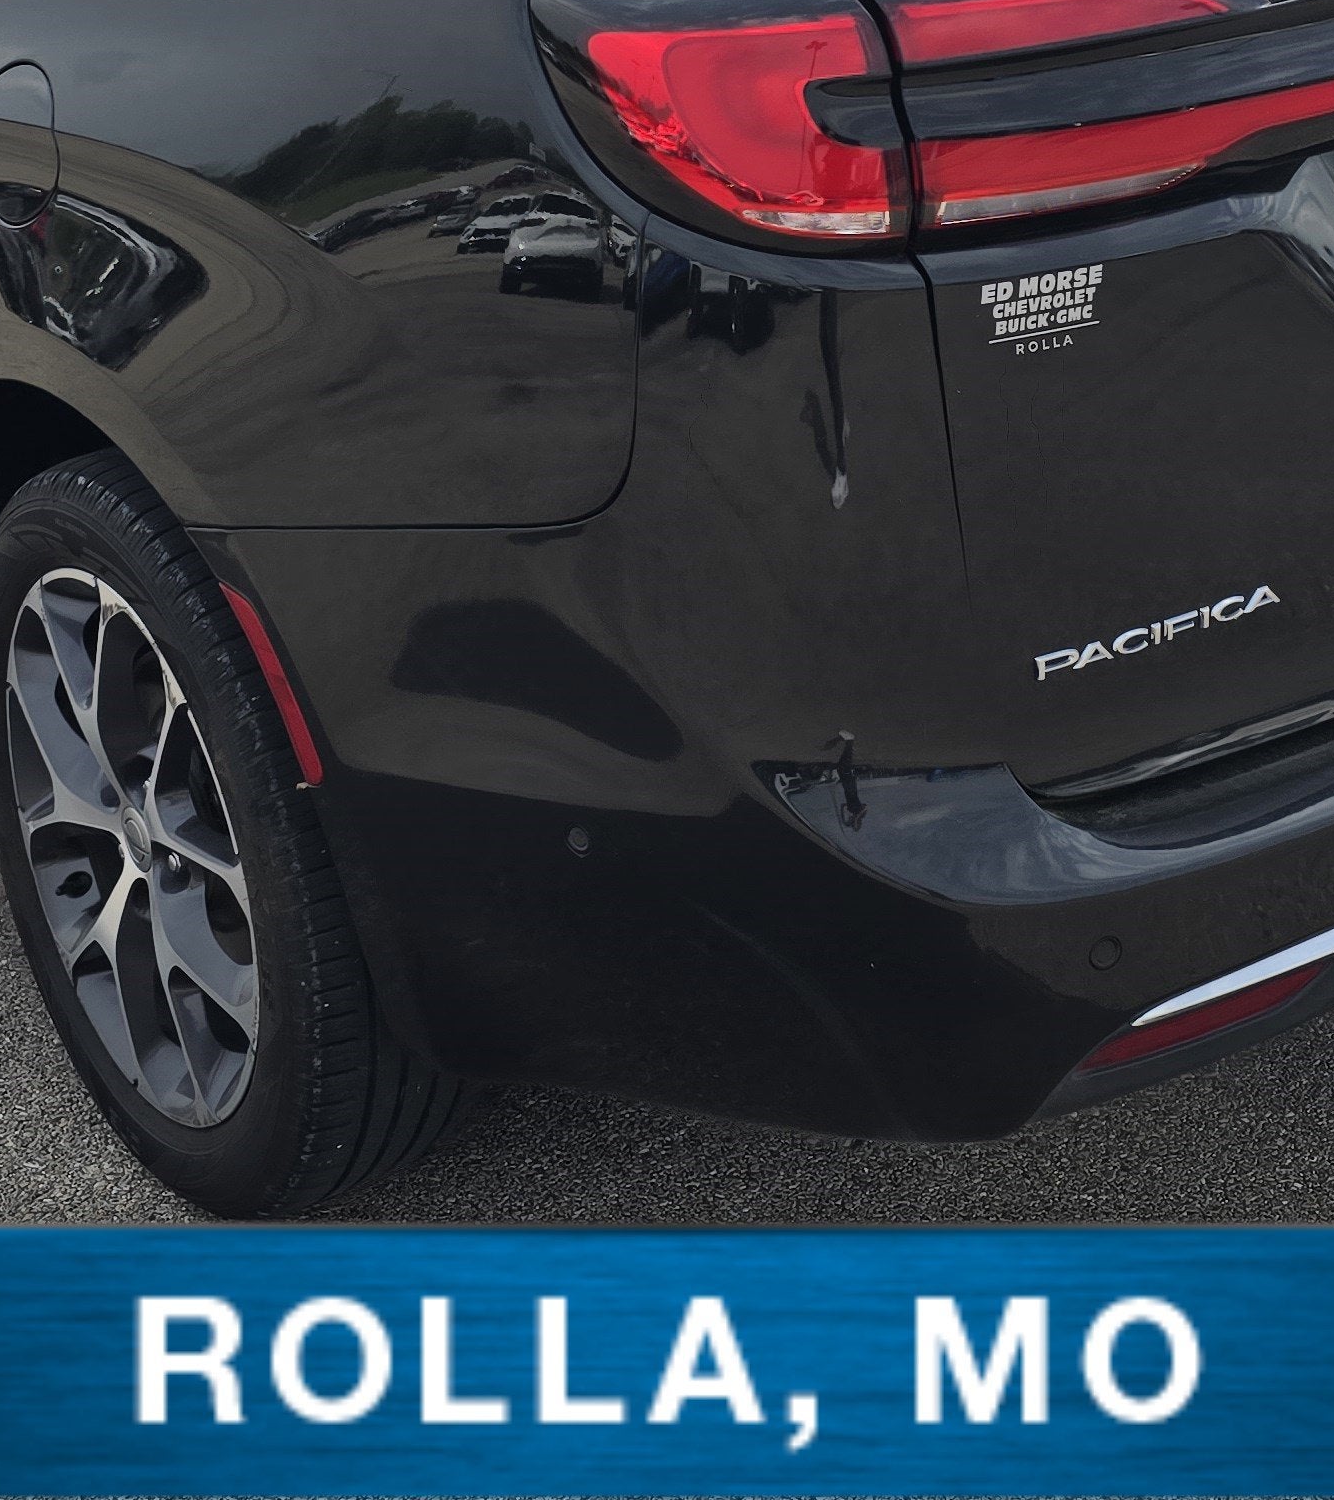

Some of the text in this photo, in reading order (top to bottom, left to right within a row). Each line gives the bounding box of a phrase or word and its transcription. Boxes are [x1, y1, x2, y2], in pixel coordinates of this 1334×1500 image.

[980, 263, 1104, 305] ED MORSE
[992, 286, 1097, 319] CHEVROLET
[1015, 334, 1075, 356] ROLLA
[1033, 584, 1281, 682] PACIFICA
